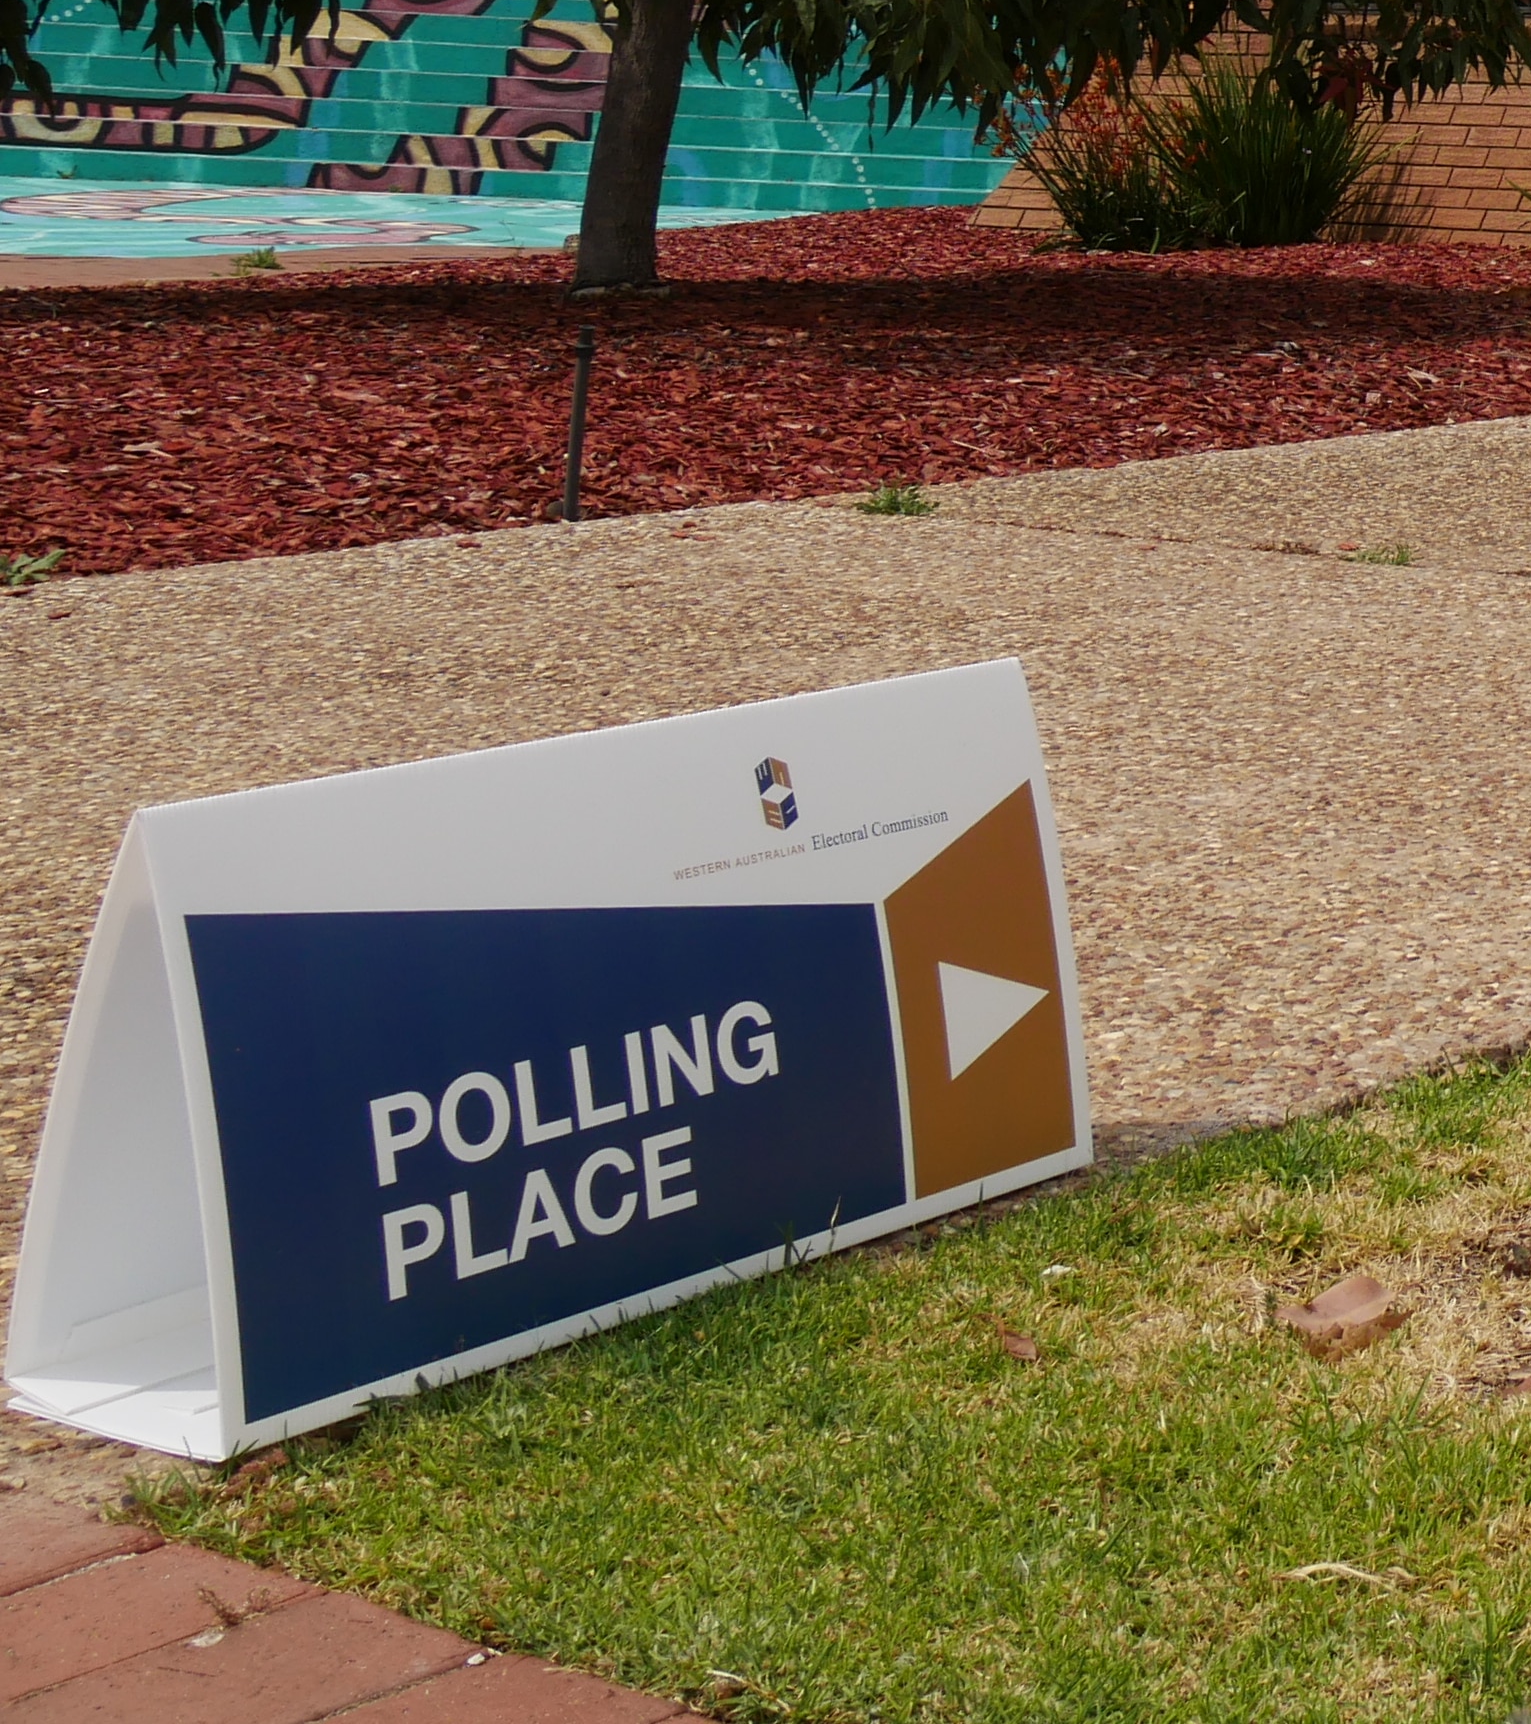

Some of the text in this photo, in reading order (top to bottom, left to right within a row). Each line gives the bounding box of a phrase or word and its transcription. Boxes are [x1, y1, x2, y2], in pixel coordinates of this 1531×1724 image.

[673, 809, 949, 881] WESTERN AUSTRALIAN Electoral Commission
[369, 1000, 780, 1187] POLLING
[382, 1126, 698, 1301] PLACE
